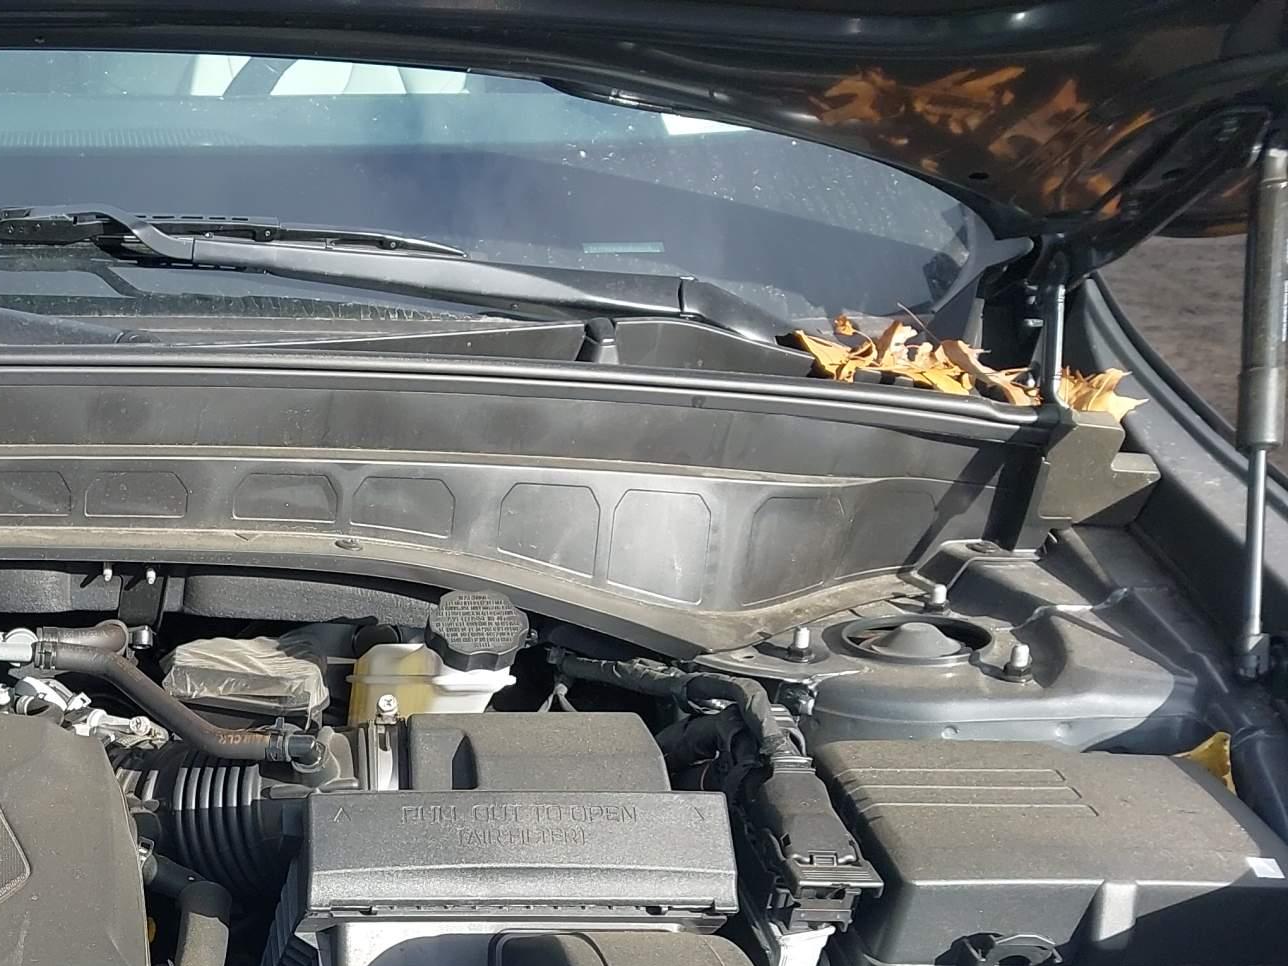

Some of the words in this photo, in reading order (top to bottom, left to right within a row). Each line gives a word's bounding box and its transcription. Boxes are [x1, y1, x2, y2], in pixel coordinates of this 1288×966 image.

[472, 804, 522, 823] OUT
[530, 804, 563, 822] TO
[569, 804, 637, 822] OPEN
